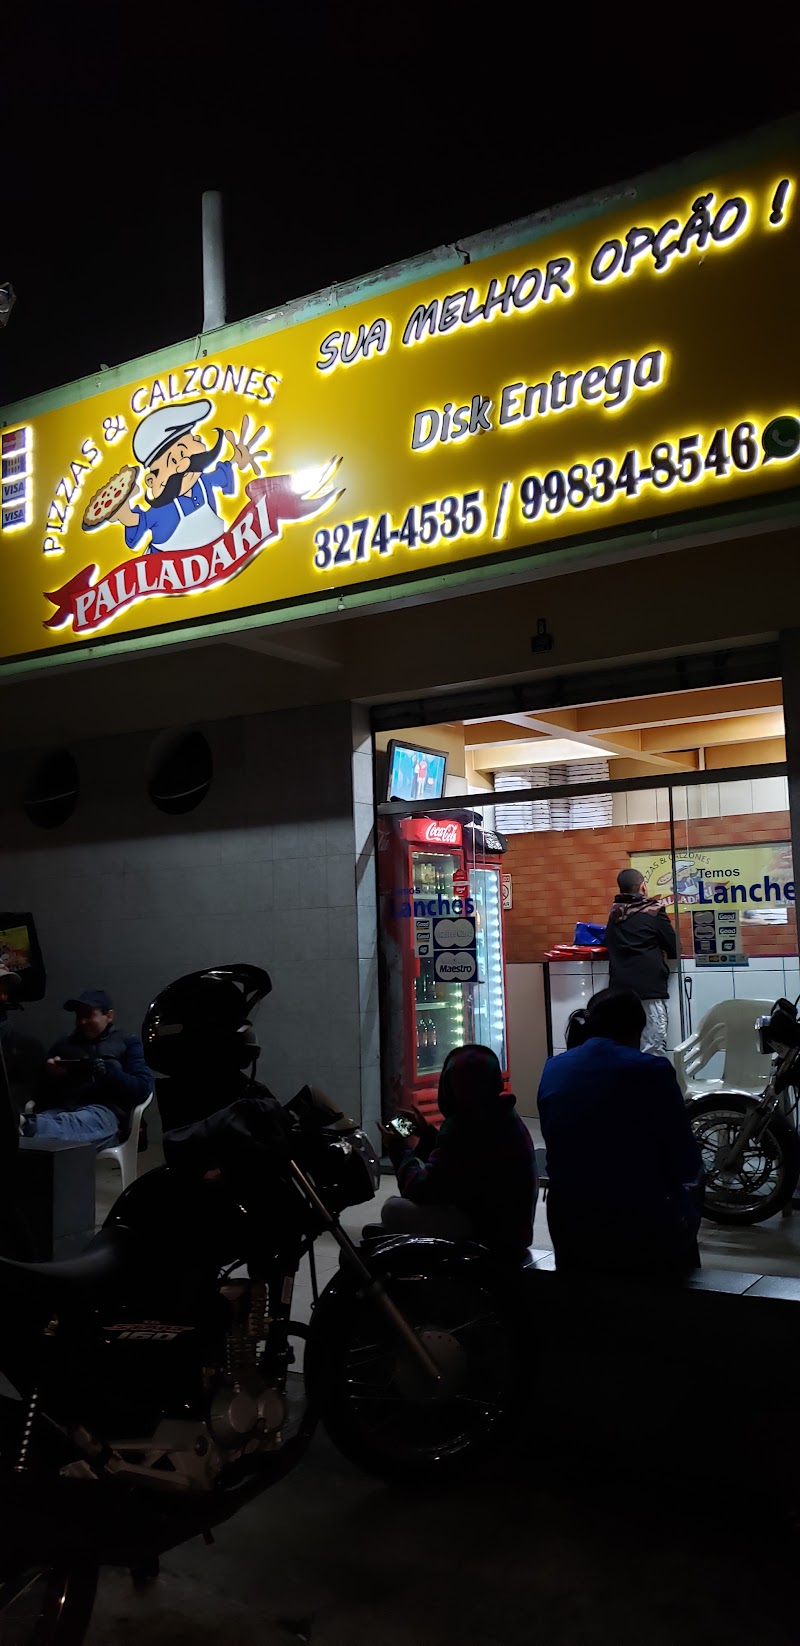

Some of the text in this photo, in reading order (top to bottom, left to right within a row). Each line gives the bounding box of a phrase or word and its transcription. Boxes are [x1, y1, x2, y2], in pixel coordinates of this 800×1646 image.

[317, 318, 387, 369] SUA
[403, 258, 572, 344] MELHOR
[591, 193, 747, 282] OPÇÃO
[411, 350, 662, 450] Disk Entrega
[4, 482, 24, 497] VISA
[43, 364, 280, 553] PIZZAS & CALZONES
[314, 490, 483, 569] 3274-4535
[520, 422, 758, 519] 99834-8546
[5, 508, 24, 522] VISA
[74, 497, 273, 628] PALLADARI
[698, 868, 740, 879] Temos
[439, 964, 472, 973] Maestro
